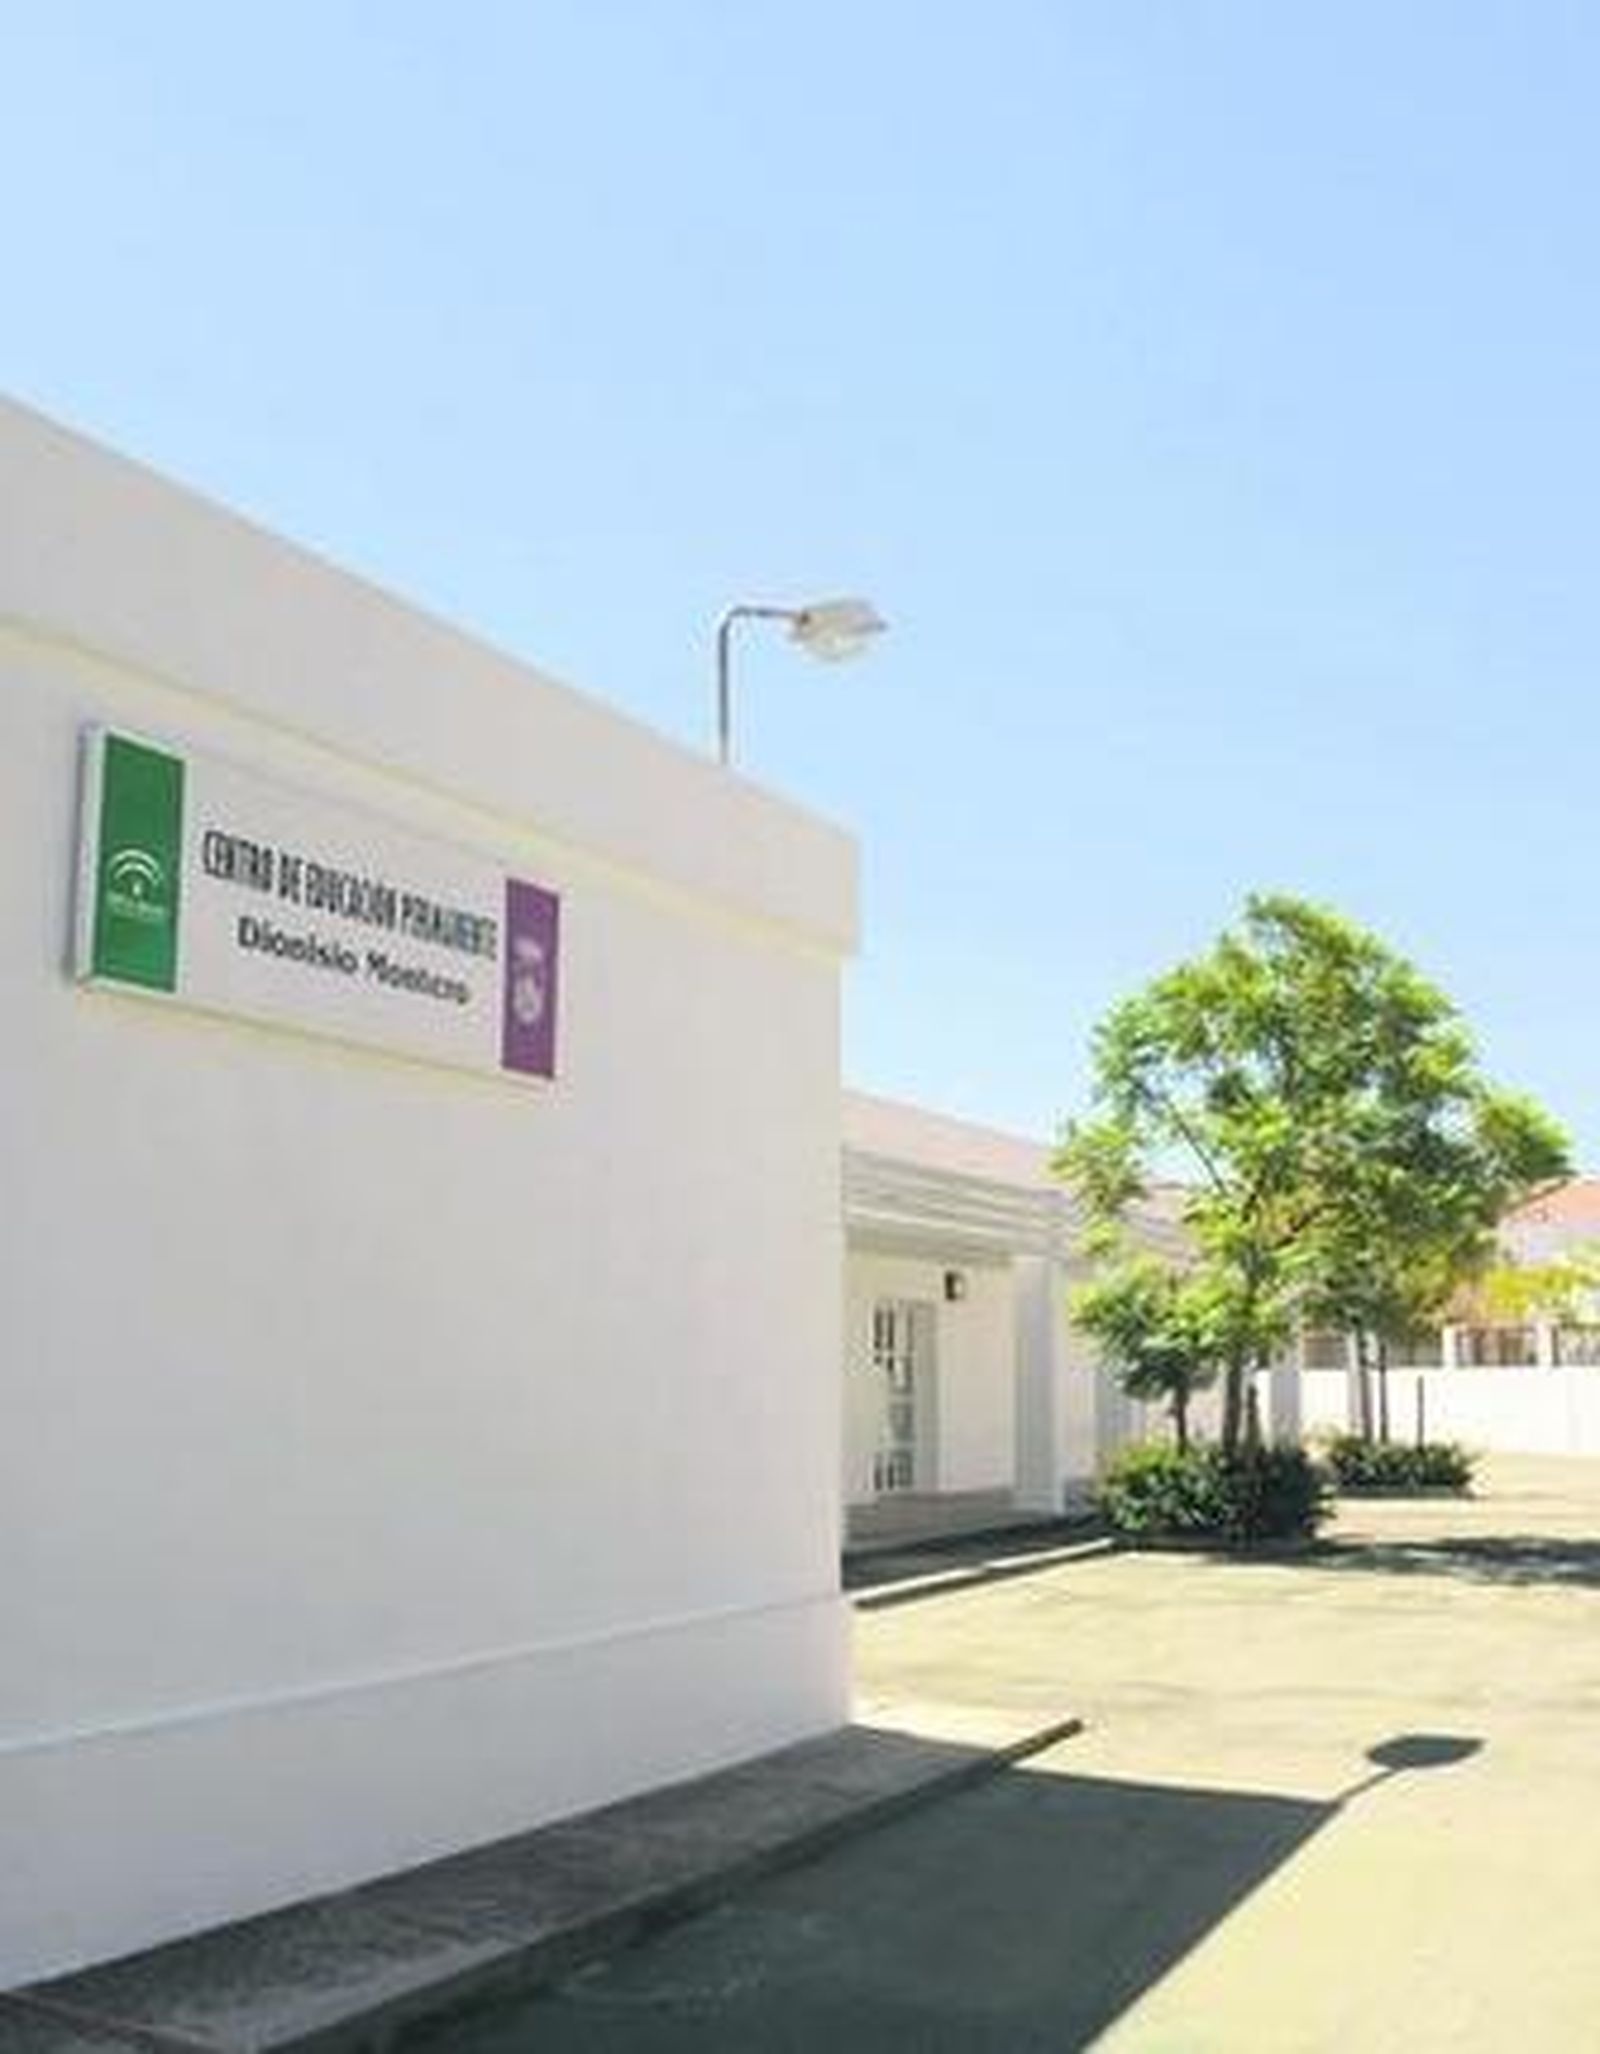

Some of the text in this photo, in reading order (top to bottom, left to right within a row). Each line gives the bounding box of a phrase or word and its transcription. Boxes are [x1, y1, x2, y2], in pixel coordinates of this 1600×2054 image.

[203, 830, 273, 892] CENTRO
[279, 853, 302, 904] DE
[238, 915, 359, 974] Dionisio
